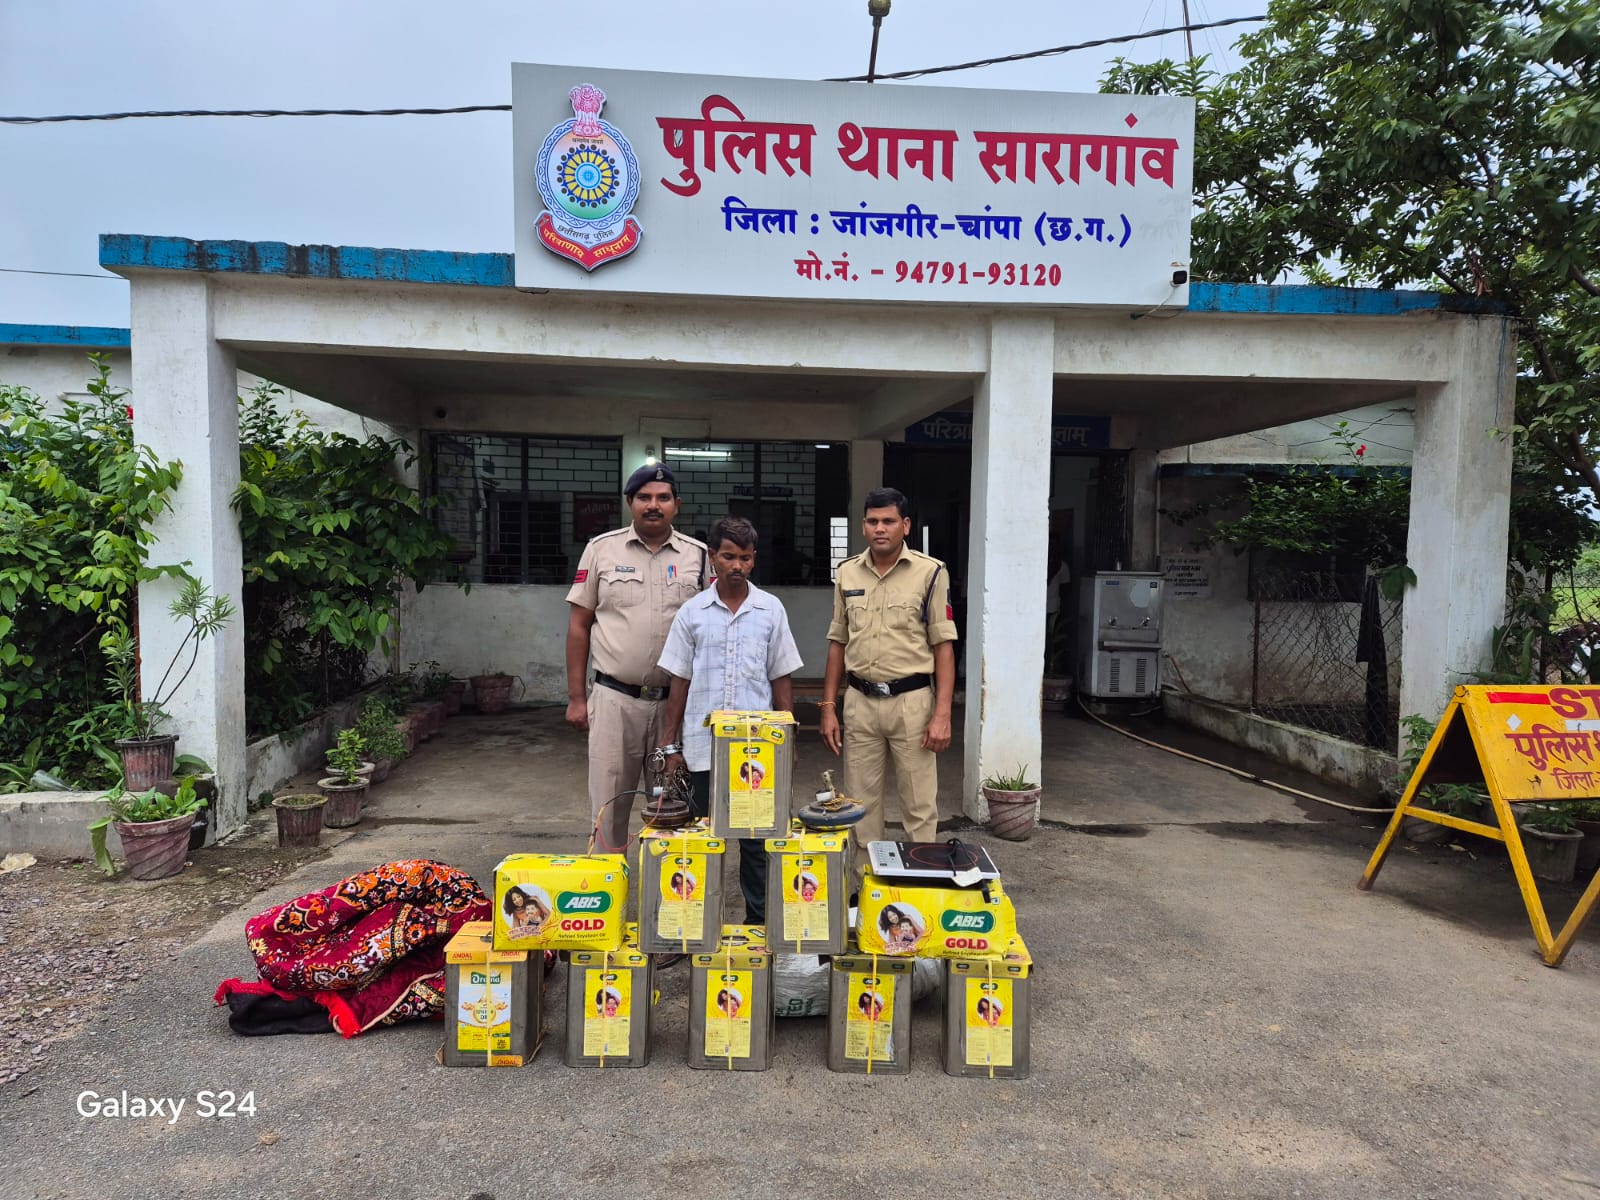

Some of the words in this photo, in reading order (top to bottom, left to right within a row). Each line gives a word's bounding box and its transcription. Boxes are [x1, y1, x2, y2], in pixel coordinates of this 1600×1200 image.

[656, 95, 817, 197] पुलिस
[838, 122, 959, 180] थाना
[974, 114, 1179, 187] सारागांव
[720, 195, 799, 234] जिला
[829, 200, 1023, 241] जांजगीर-चांपा
[1034, 211, 1132, 249] (छ.ग.)
[593, 228, 615, 242] पुलिस
[794, 251, 859, 281] मो.नं.
[895, 261, 1062, 286] 94791-93120
[1503, 723, 1595, 771] पुलिस
[1549, 766, 1596, 791] जिला
[565, 896, 602, 909] ABIS
[560, 919, 605, 931] GOLD
[949, 914, 986, 928] ABIS
[945, 937, 989, 951] GOLD
